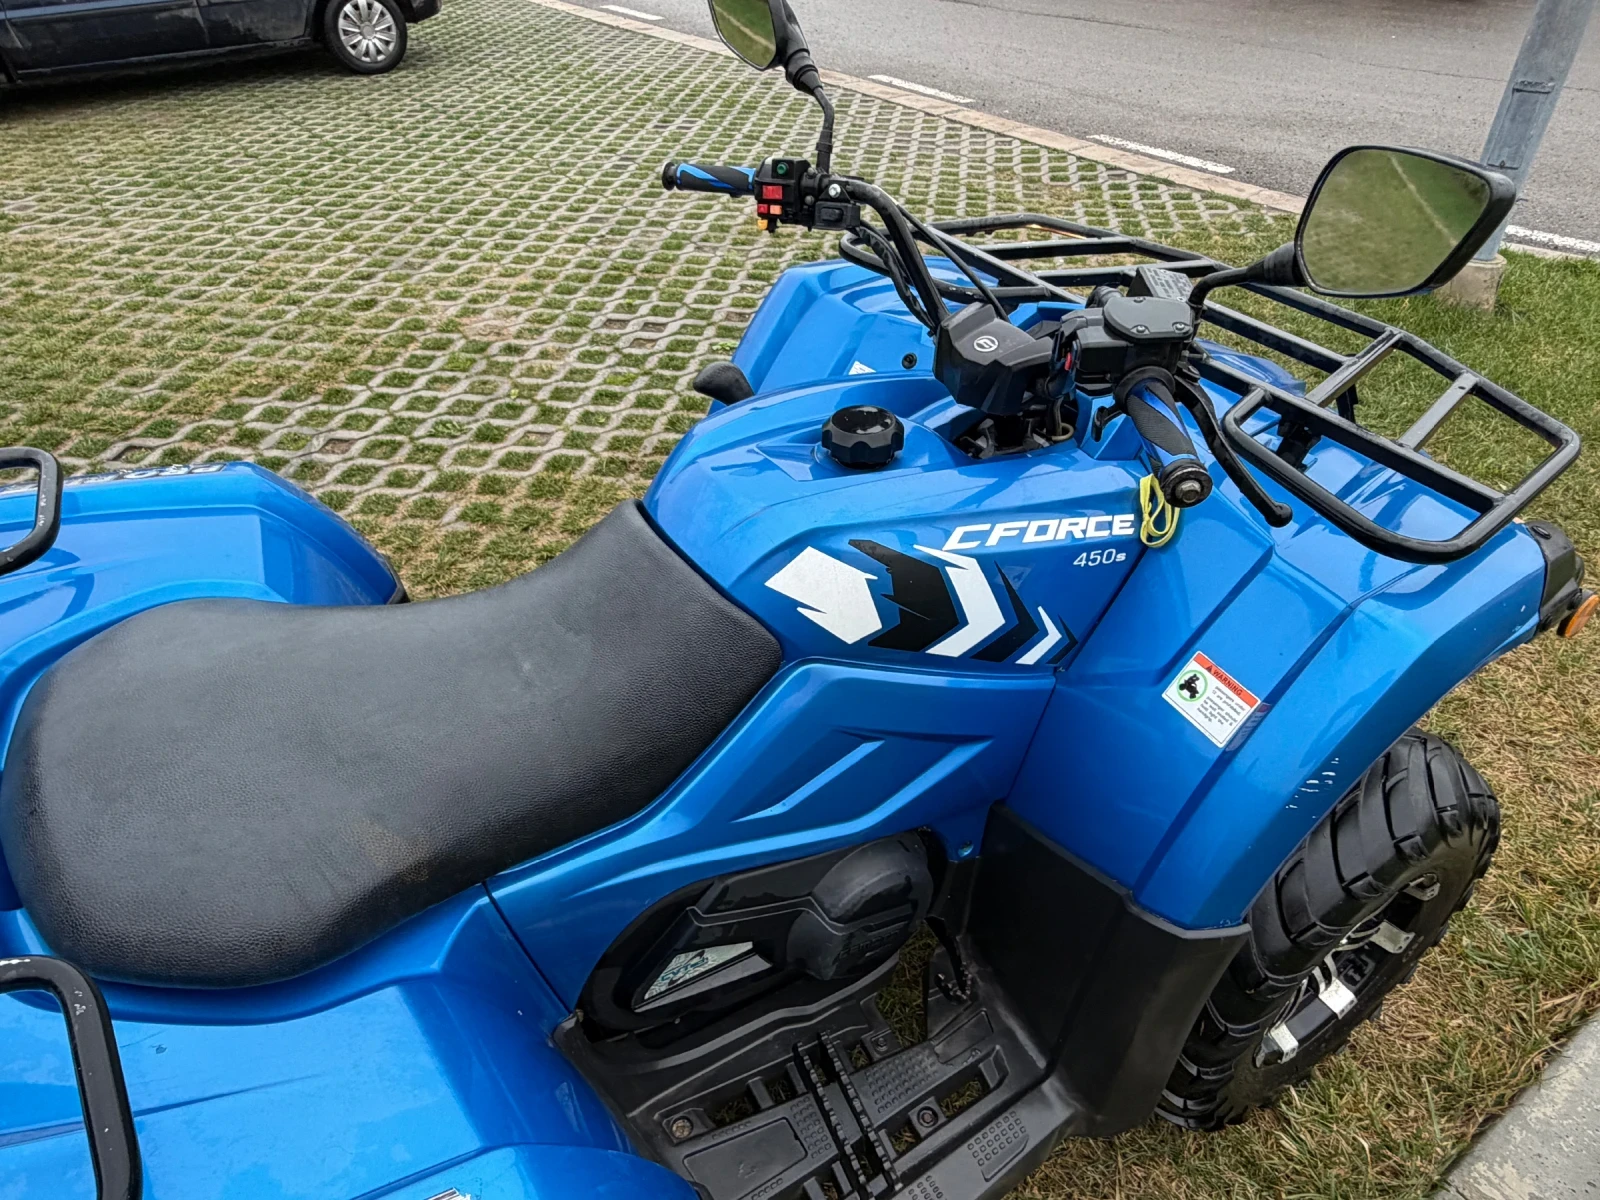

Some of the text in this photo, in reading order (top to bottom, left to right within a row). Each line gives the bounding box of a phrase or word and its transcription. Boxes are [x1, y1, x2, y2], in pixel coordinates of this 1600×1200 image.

[942, 513, 1135, 551] CFORCE
[1073, 548, 1127, 567] 450s
[1213, 669, 1243, 696] WARNING
